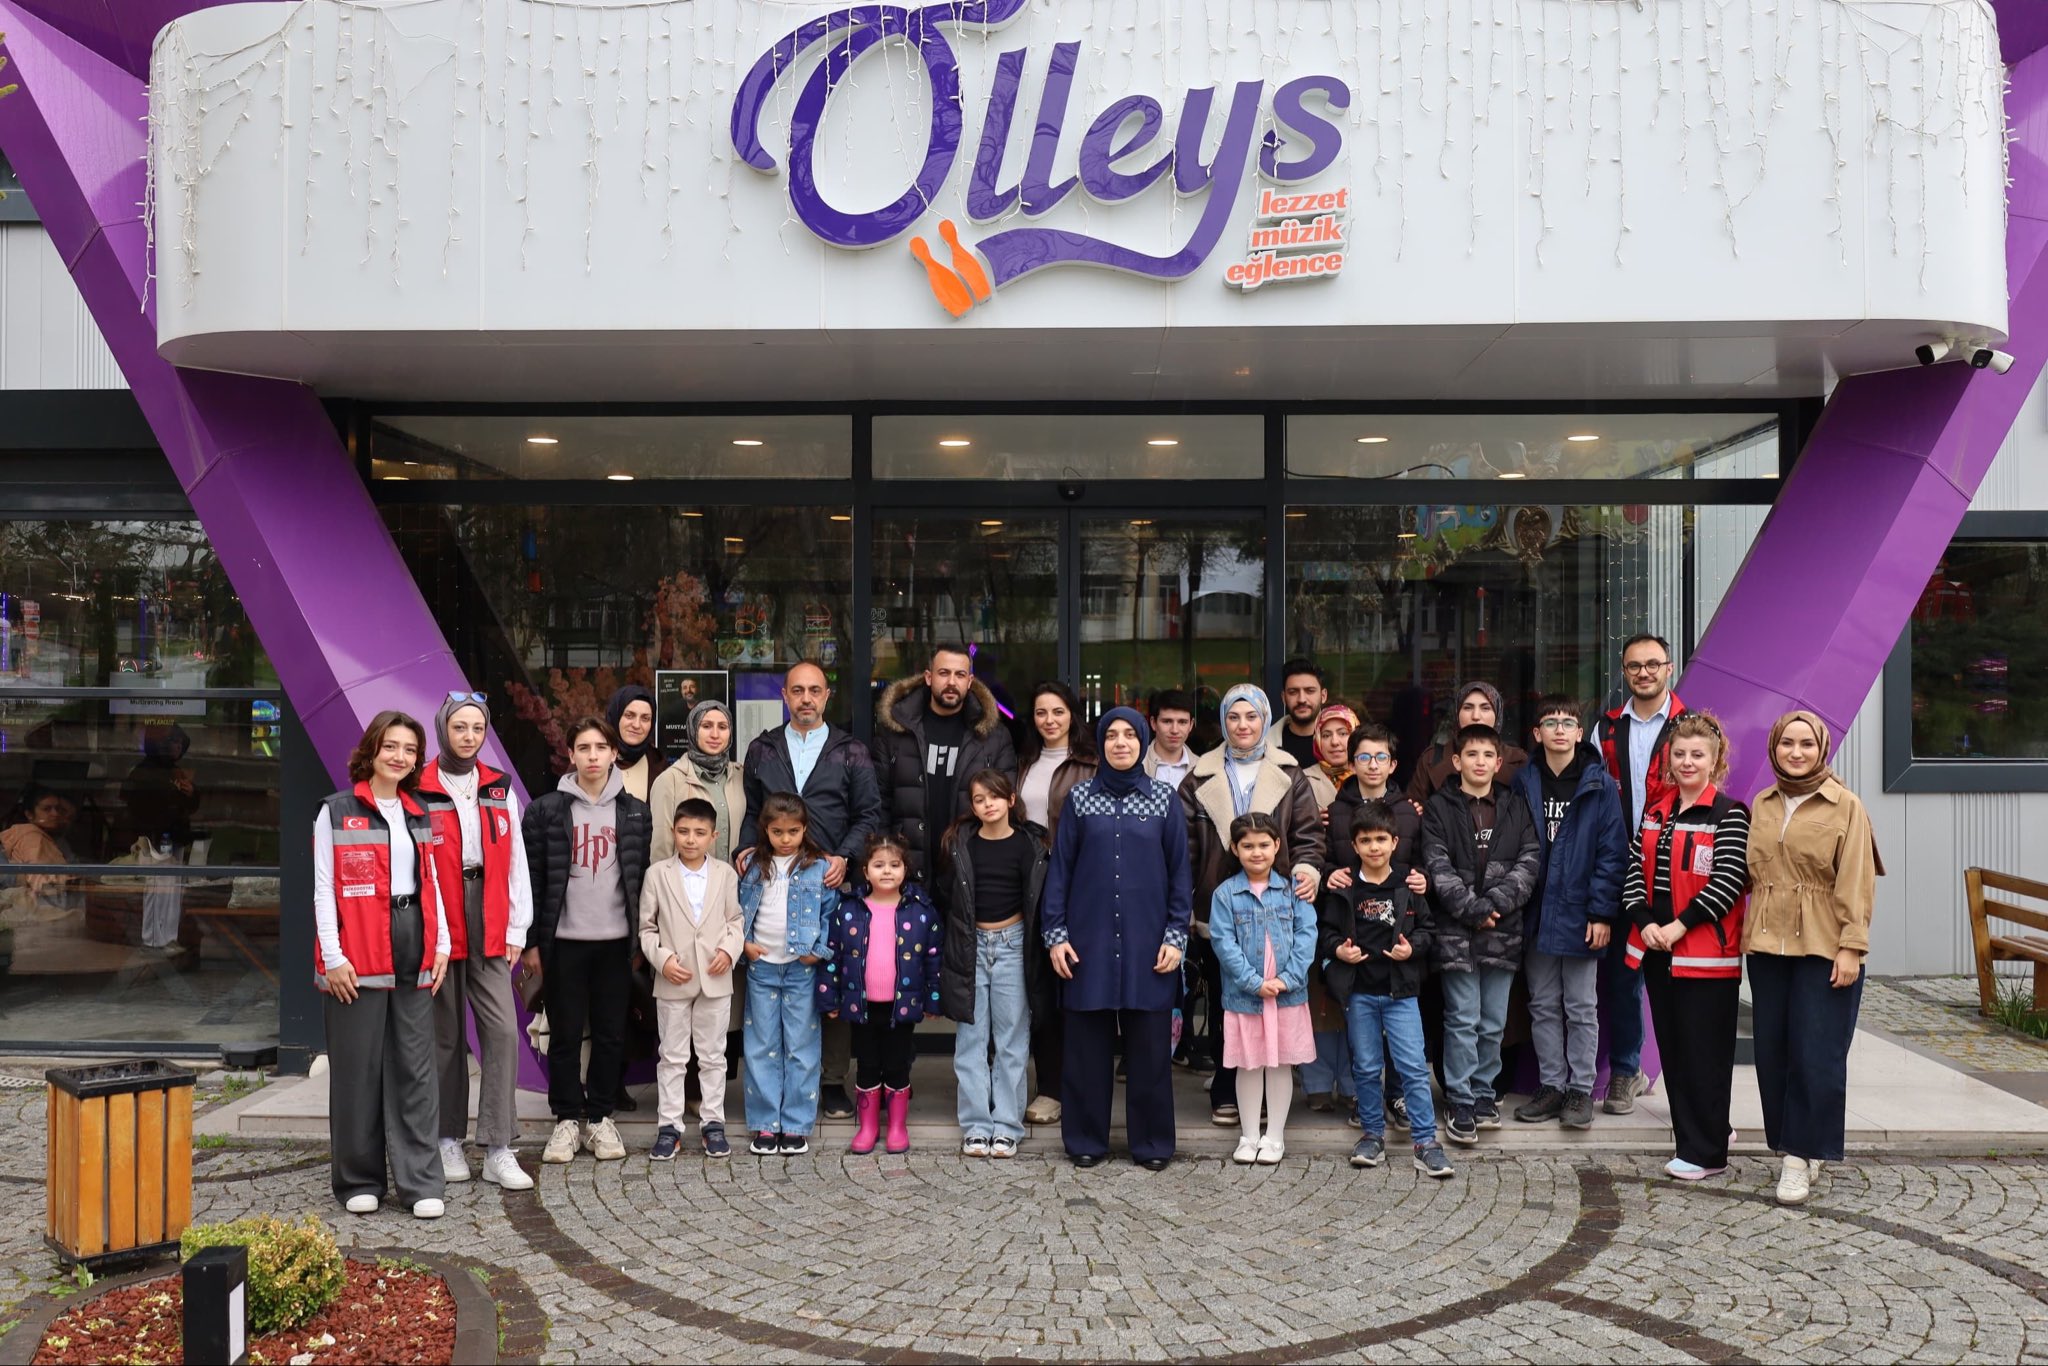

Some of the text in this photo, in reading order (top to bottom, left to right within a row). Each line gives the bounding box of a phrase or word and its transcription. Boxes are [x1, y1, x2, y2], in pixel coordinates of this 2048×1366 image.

[731, 0, 1351, 282] Olleys
[1261, 189, 1348, 214] lezzet
[1251, 216, 1343, 247] müzik
[1226, 253, 1343, 286] eğlence
